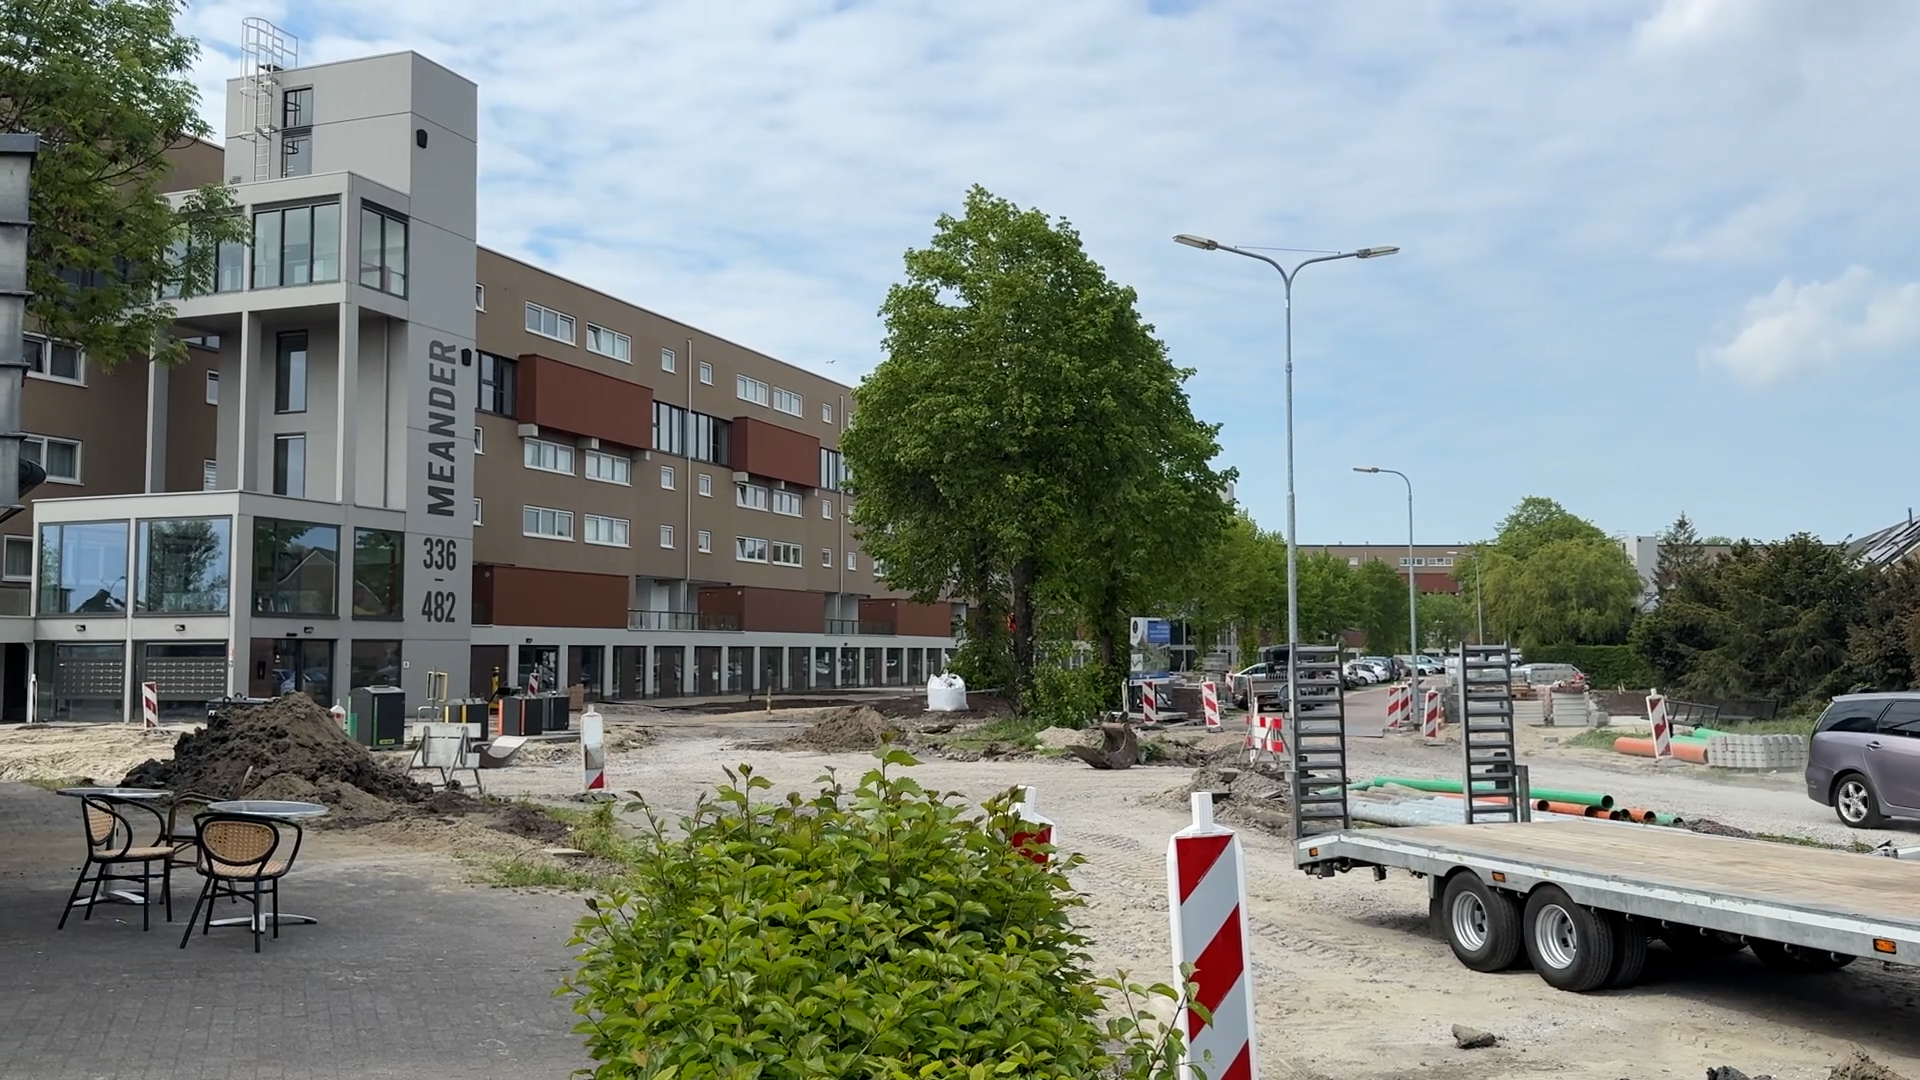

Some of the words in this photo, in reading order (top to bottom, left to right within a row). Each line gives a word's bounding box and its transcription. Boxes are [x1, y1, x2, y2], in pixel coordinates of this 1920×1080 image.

[427, 339, 457, 517] MEANDER
[423, 537, 457, 571] 336
[421, 590, 456, 623] 482
